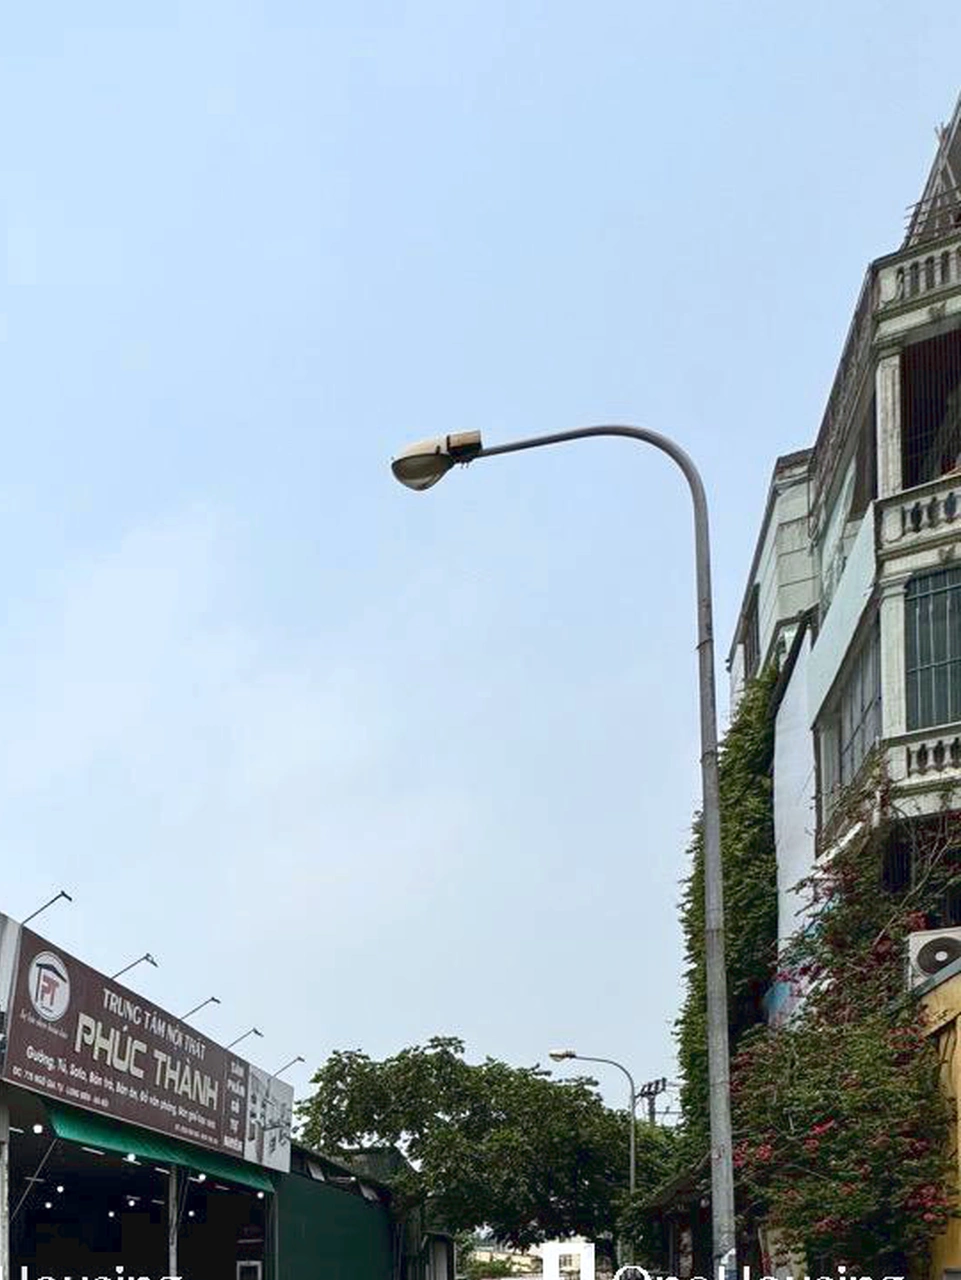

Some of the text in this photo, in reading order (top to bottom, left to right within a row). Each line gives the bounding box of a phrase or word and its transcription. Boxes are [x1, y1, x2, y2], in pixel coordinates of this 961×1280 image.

[103, 987, 142, 1026] TRUNG
[74, 1012, 147, 1080] PHÚC
[153, 1048, 219, 1112] THÀNH
